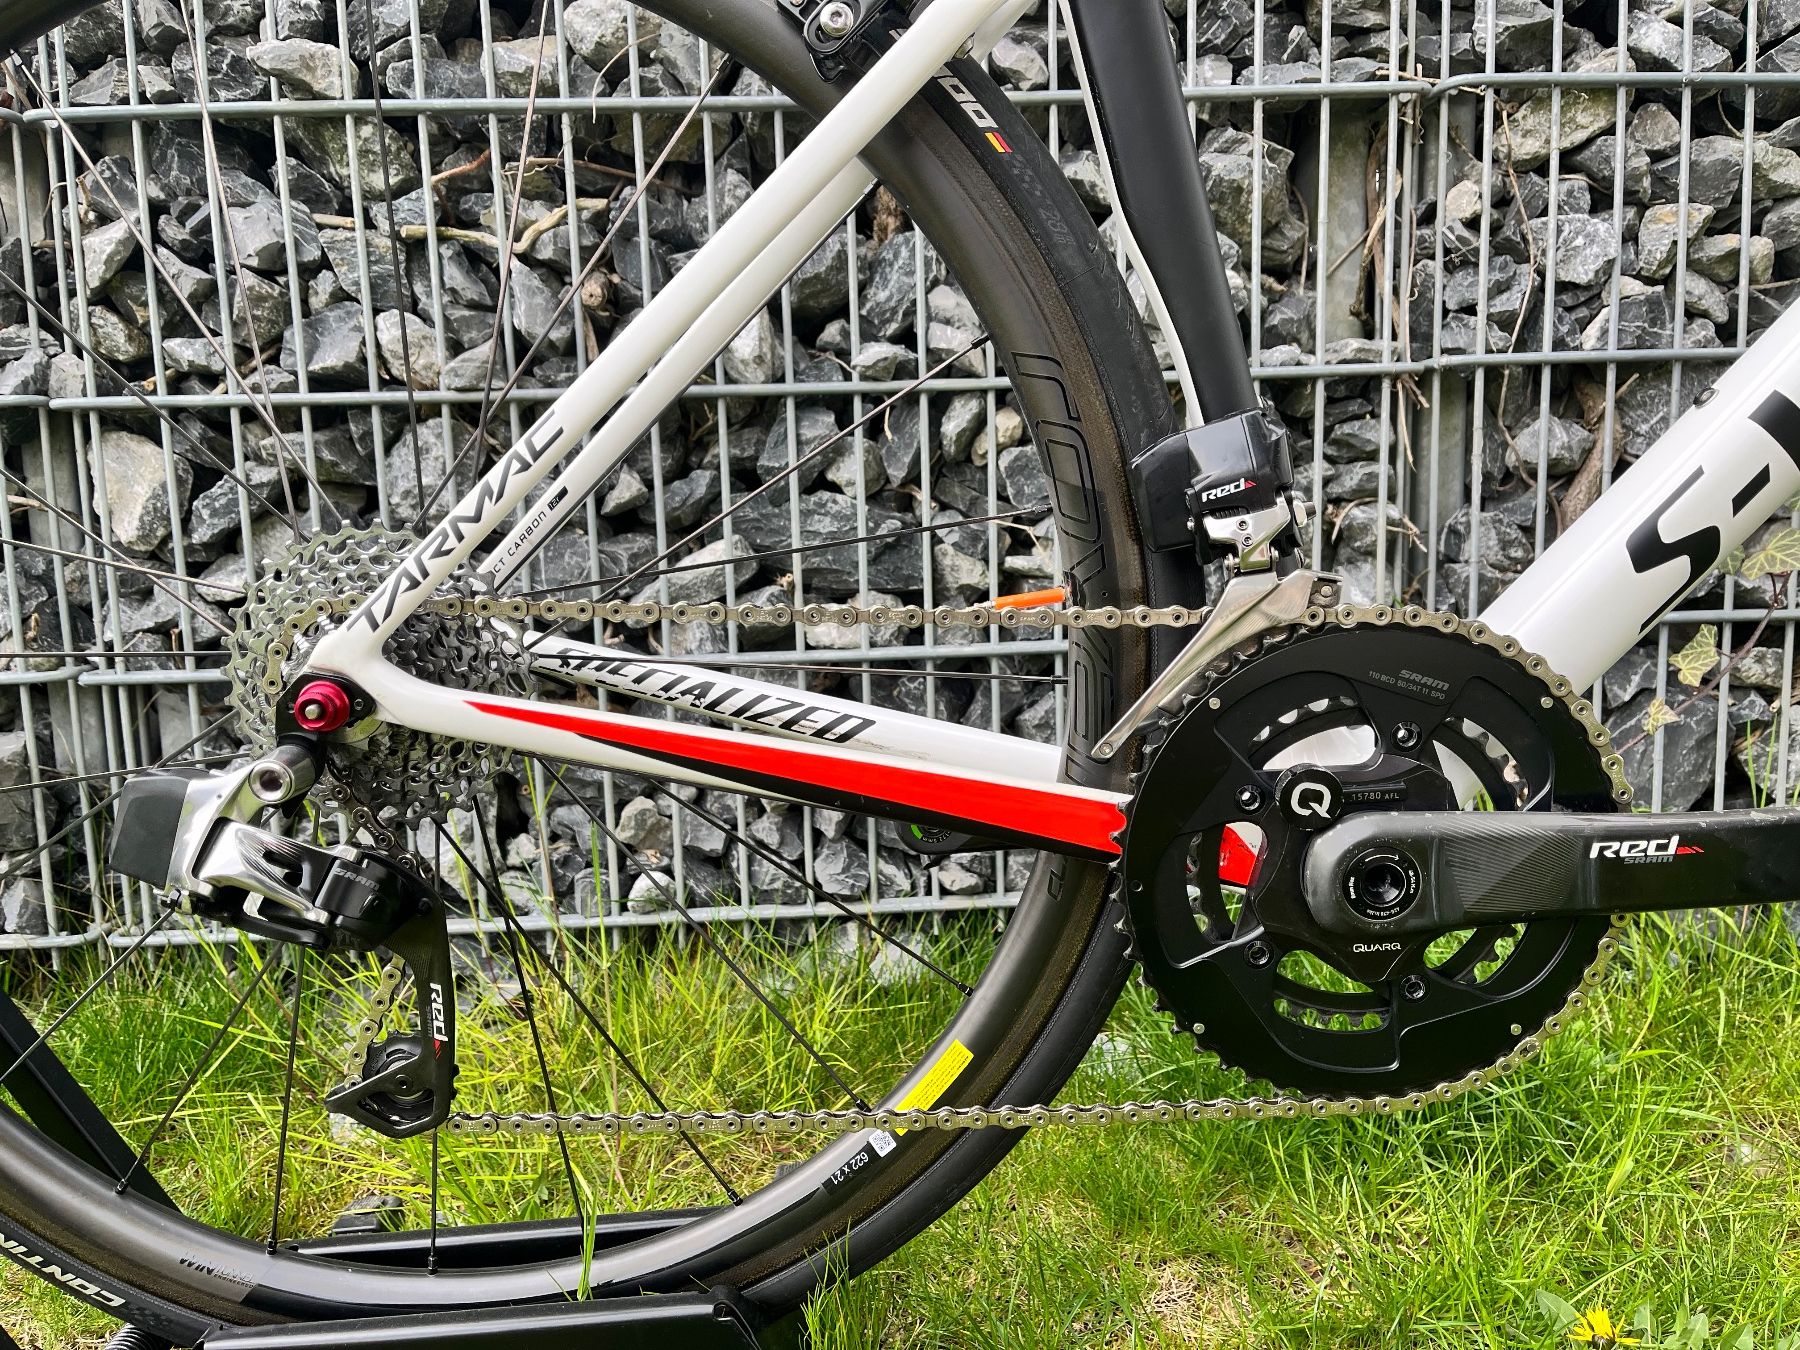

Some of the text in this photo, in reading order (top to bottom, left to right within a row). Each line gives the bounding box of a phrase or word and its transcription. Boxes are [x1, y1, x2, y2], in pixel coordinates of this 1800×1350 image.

[346, 409, 564, 633] TARMAC
[493, 557, 506, 573] CT
[507, 511, 547, 556] CARBON
[1368, 670, 1380, 680] 110
[1380, 674, 1395, 684] BCD
[1399, 669, 1450, 691] SRAM
[539, 647, 876, 744] SPECIALIZED
[1290, 782, 1332, 819] Q
[1624, 855, 1675, 865] SRAM
[334, 867, 381, 891] SRAM
[1353, 943, 1401, 953] QUARQ
[849, 1151, 869, 1170] 622
[830, 1170, 844, 1185] 21
